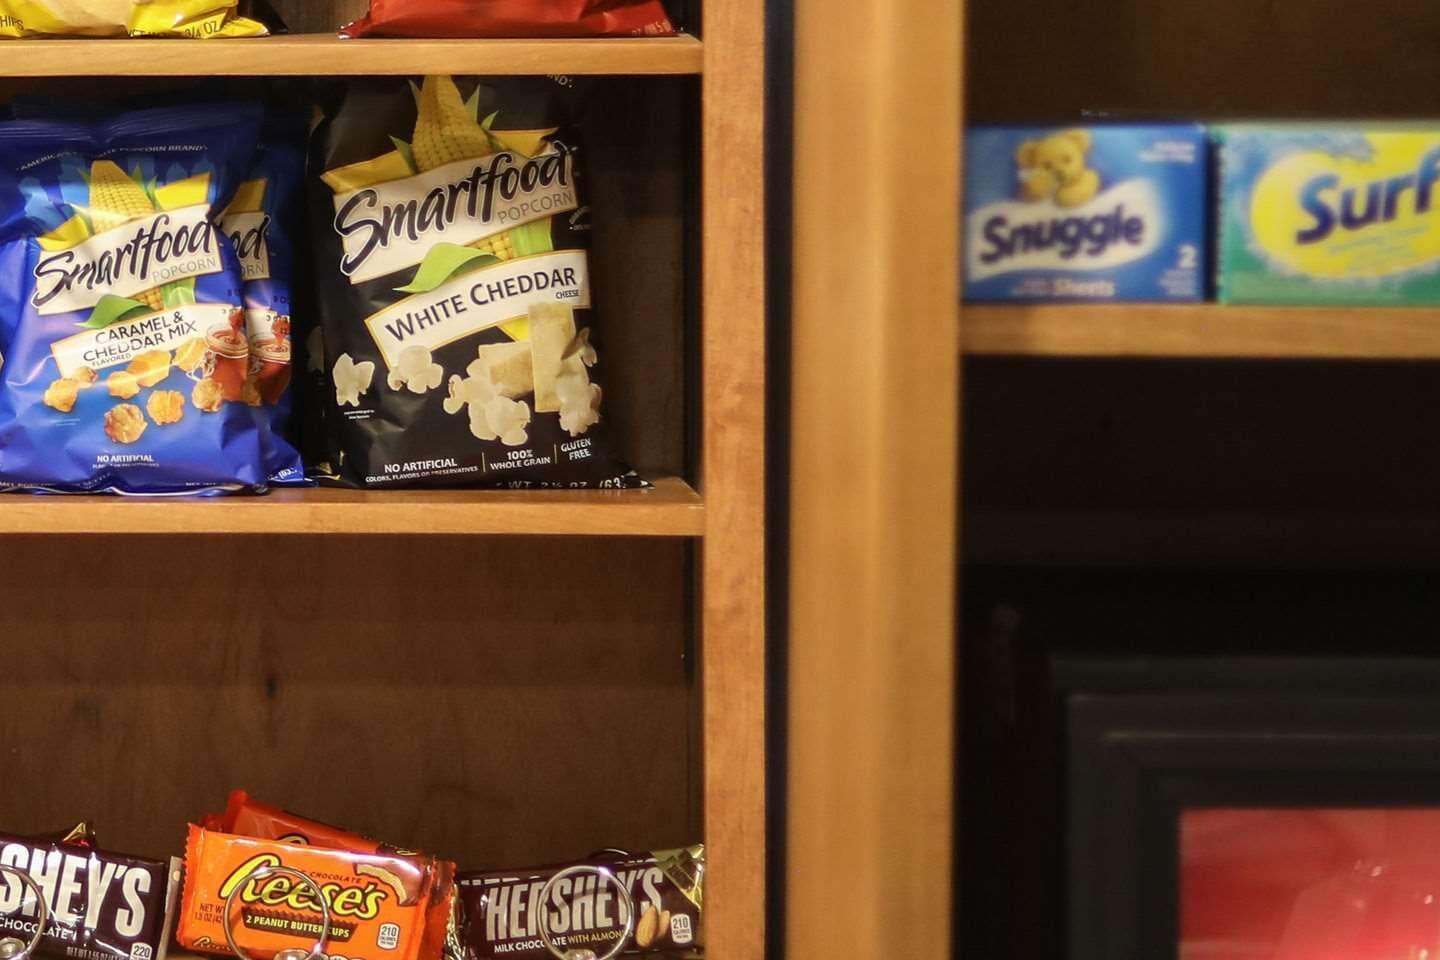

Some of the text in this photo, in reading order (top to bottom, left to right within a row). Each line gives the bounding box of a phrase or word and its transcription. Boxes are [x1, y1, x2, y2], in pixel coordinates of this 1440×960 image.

[497, 190, 573, 225] POPCORN
[1296, 147, 1440, 245] Surf
[335, 152, 568, 274] Smartfood
[981, 205, 1145, 263] Snuggle
[32, 213, 211, 307] Smartfood
[1179, 244, 1197, 269] 2
[152, 257, 217, 283] POPCORN
[385, 267, 577, 342] WHITE CHEDDAR
[555, 289, 580, 300] CHEESE
[95, 311, 184, 344] CARAMEL &
[83, 320, 199, 362] CHEDDAR MIX
[507, 449, 534, 461] 100%
[560, 438, 592, 452] GLUTEN
[569, 448, 592, 461] FREE
[97, 455, 110, 463] NO
[384, 458, 458, 473] NO ARTIFICIAL
[490, 456, 552, 471] WHOLE GRAIN
[365, 474, 392, 483] COLORS,
[392, 472, 420, 481] FLAVORS
[220, 854, 387, 918] Reese's
[310, 871, 362, 883] CHOCOLATE
[199, 903, 224, 914] NET W
[486, 867, 664, 941] HERSHEY'S
[246, 915, 350, 938] 2 PEANUT BUTTER UPS
[382, 926, 397, 937] 210
[672, 917, 689, 930] 210
[133, 945, 151, 957] 220
[494, 929, 634, 953] MILK CHOCATE WITH ALMONS
